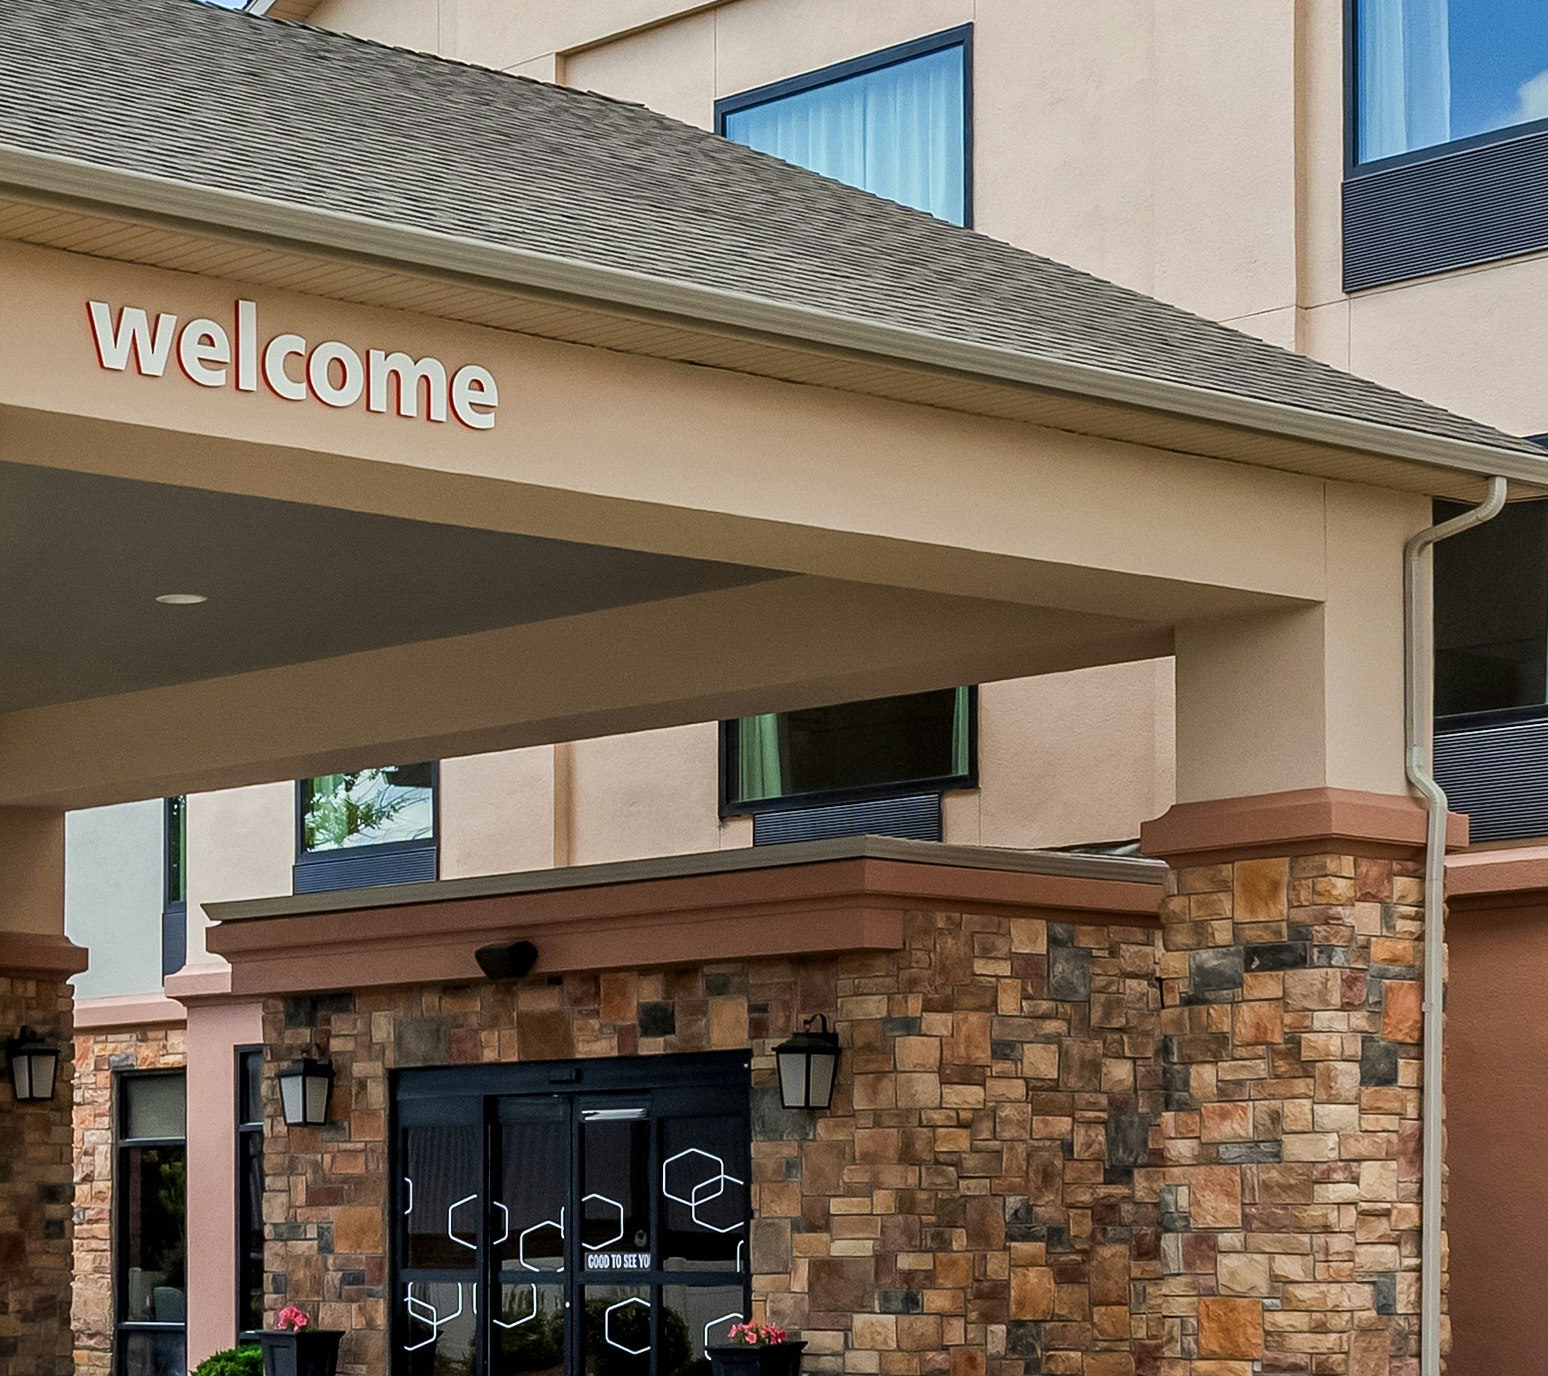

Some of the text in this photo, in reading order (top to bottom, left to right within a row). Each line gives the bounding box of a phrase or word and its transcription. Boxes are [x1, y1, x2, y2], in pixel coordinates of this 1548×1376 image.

[86, 299, 499, 430] welcome
[588, 1253, 651, 1269] GOOD TO SEE YO
